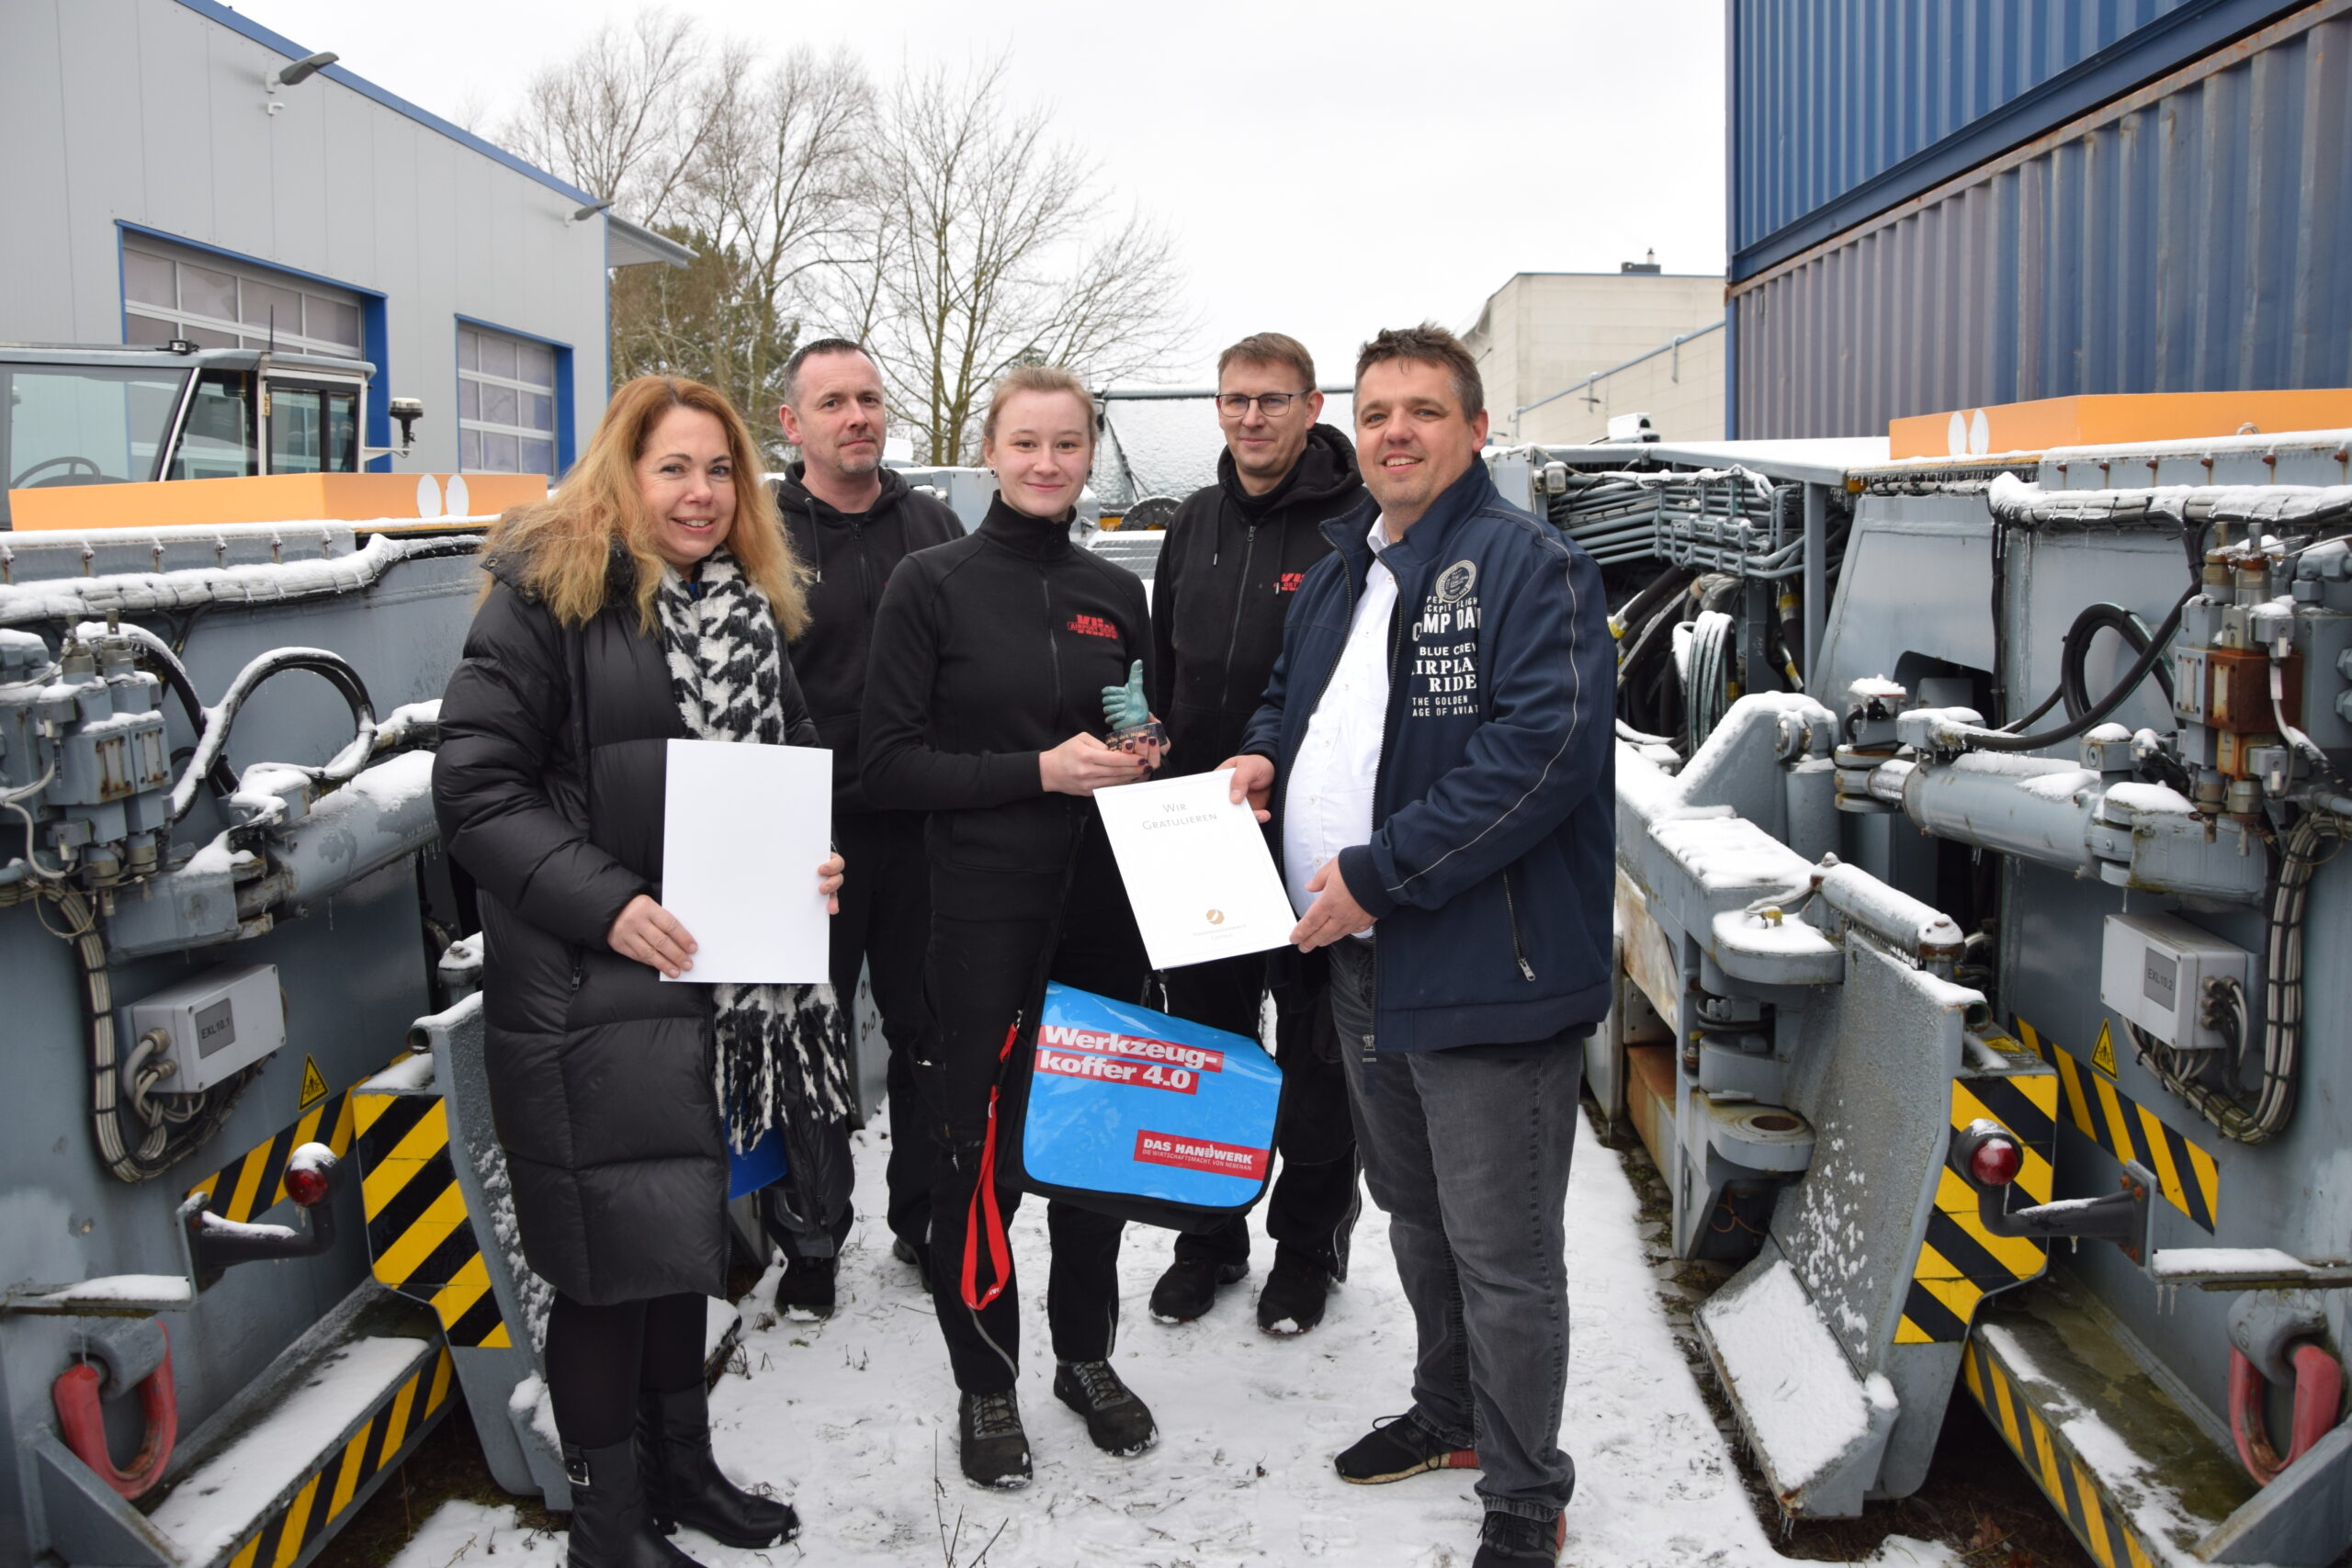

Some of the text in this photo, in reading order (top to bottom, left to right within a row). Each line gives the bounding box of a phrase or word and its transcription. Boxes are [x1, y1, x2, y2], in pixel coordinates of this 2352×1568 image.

[1412, 613, 1451, 642] CMP
[1419, 647, 1449, 656] BLUE
[1411, 657, 1476, 676] IRPLA
[1429, 674, 1477, 693] RIDE
[1412, 695, 1467, 705] THE GOLDEN
[1412, 708, 1430, 716] AGE
[1436, 708, 1447, 716] OF
[1142, 813, 1217, 830] GRATULIEREN
[2147, 967, 2174, 991] EXL10.2
[201, 1017, 230, 1040] EXL10.1
[1044, 1025, 1217, 1070] Werkzeug-
[1040, 1050, 1191, 1089] koffer 4.0
[1144, 1139, 1253, 1165] DAS HANDWERK
